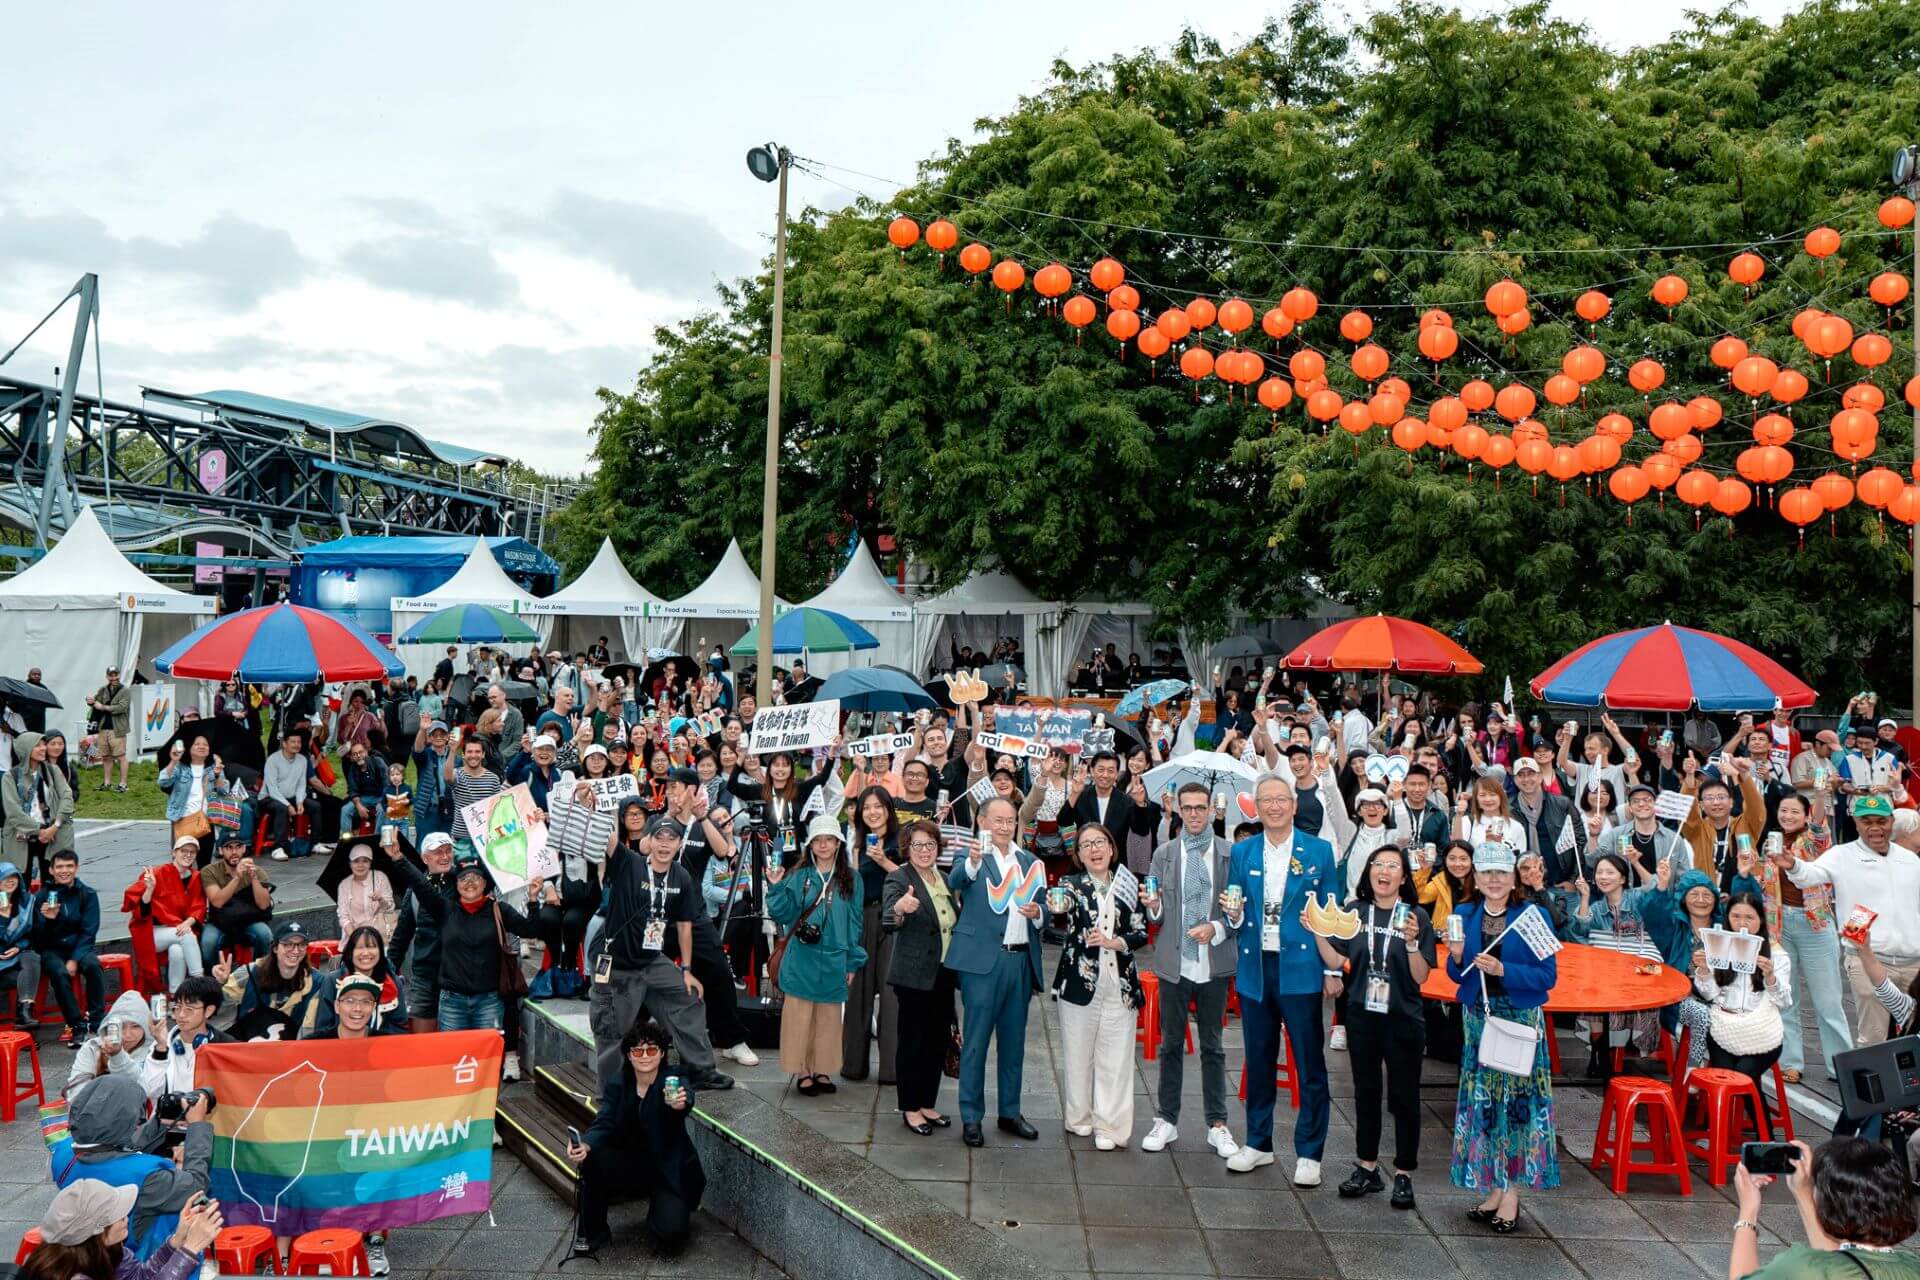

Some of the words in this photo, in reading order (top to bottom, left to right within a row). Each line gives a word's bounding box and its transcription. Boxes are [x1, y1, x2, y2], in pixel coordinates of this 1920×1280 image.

[136, 599, 166, 607] Information
[756, 735, 778, 748] Team
[780, 732, 810, 746] Taiwan
[452, 1054, 479, 1084] 台
[345, 1115, 472, 1157] TAIWAN
[439, 1170, 469, 1203] 灣
